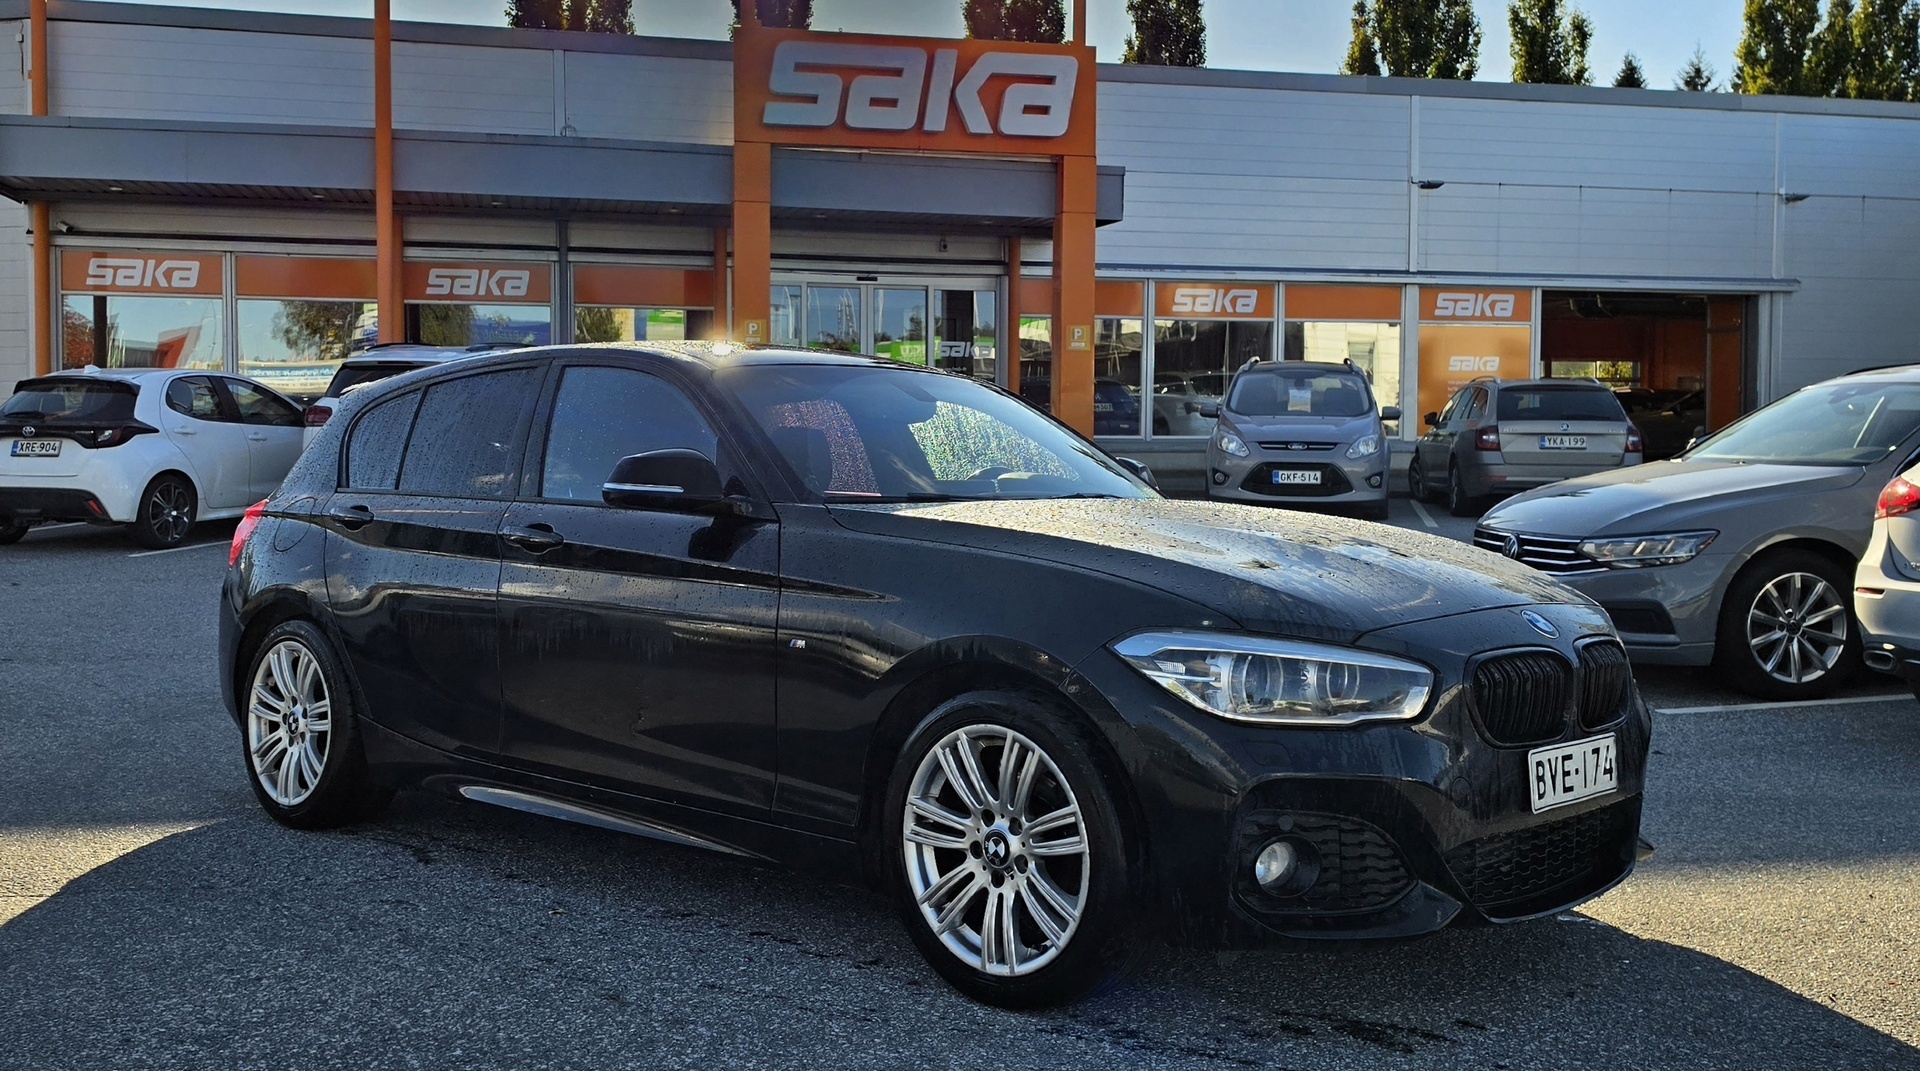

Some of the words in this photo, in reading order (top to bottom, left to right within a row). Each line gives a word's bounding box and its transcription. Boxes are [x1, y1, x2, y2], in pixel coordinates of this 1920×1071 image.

[19, 442, 57, 453] XRE-904
[1546, 437, 1586, 447] YKA-199
[1280, 472, 1319, 483] GKF-514
[1535, 744, 1614, 801] BVE-174
